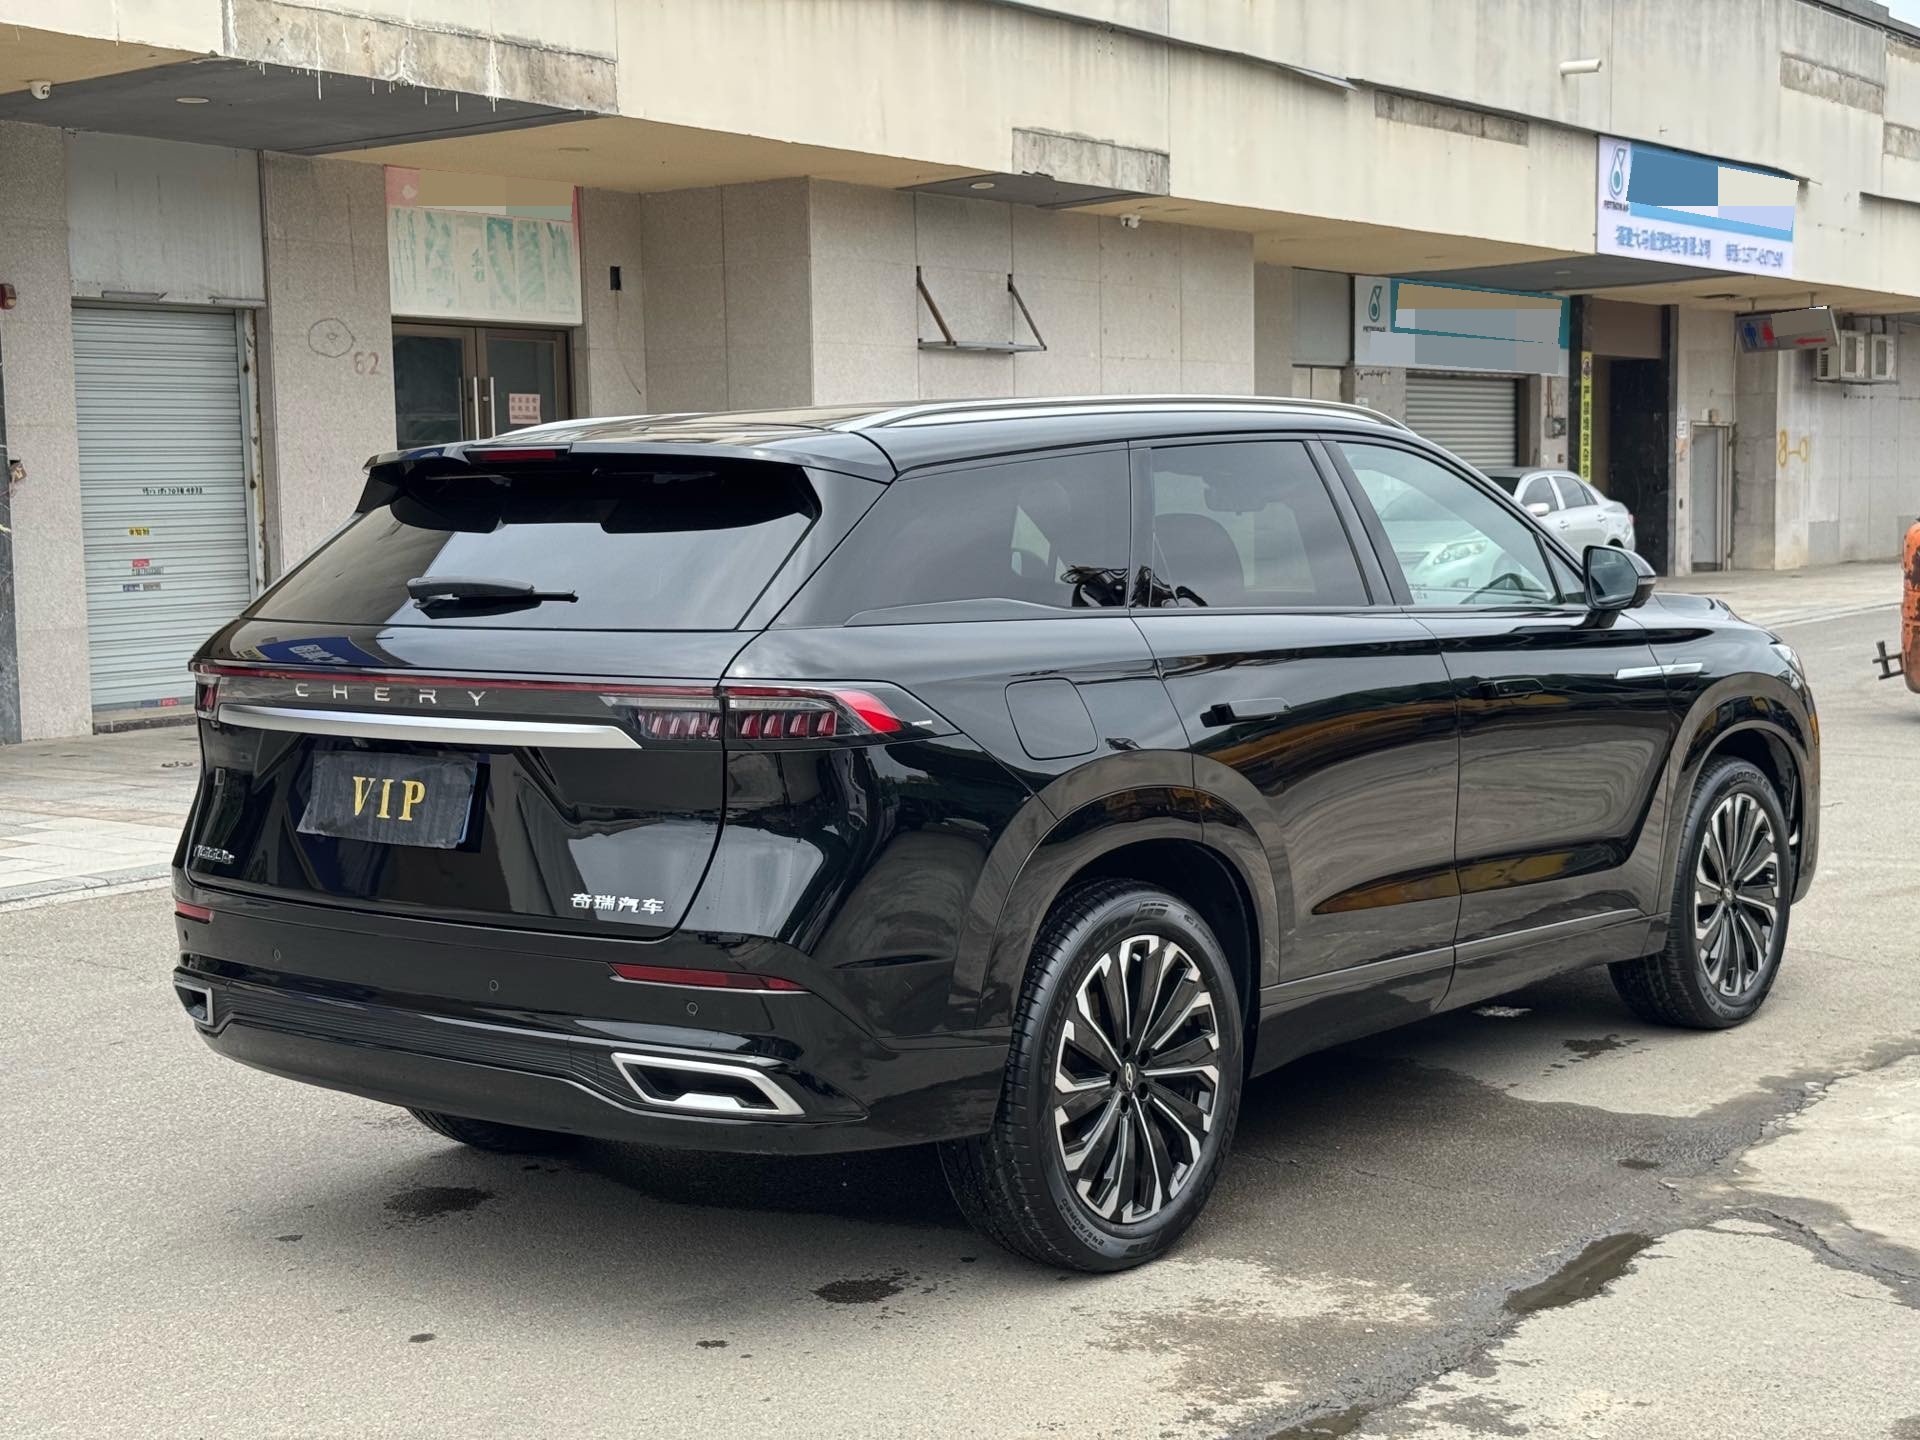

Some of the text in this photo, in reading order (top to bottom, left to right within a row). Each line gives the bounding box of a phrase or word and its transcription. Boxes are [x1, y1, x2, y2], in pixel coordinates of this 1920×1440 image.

[295, 683, 486, 706] CHERY
[352, 775, 426, 821] VIP
[570, 893, 665, 915] 奇瑞汽车
